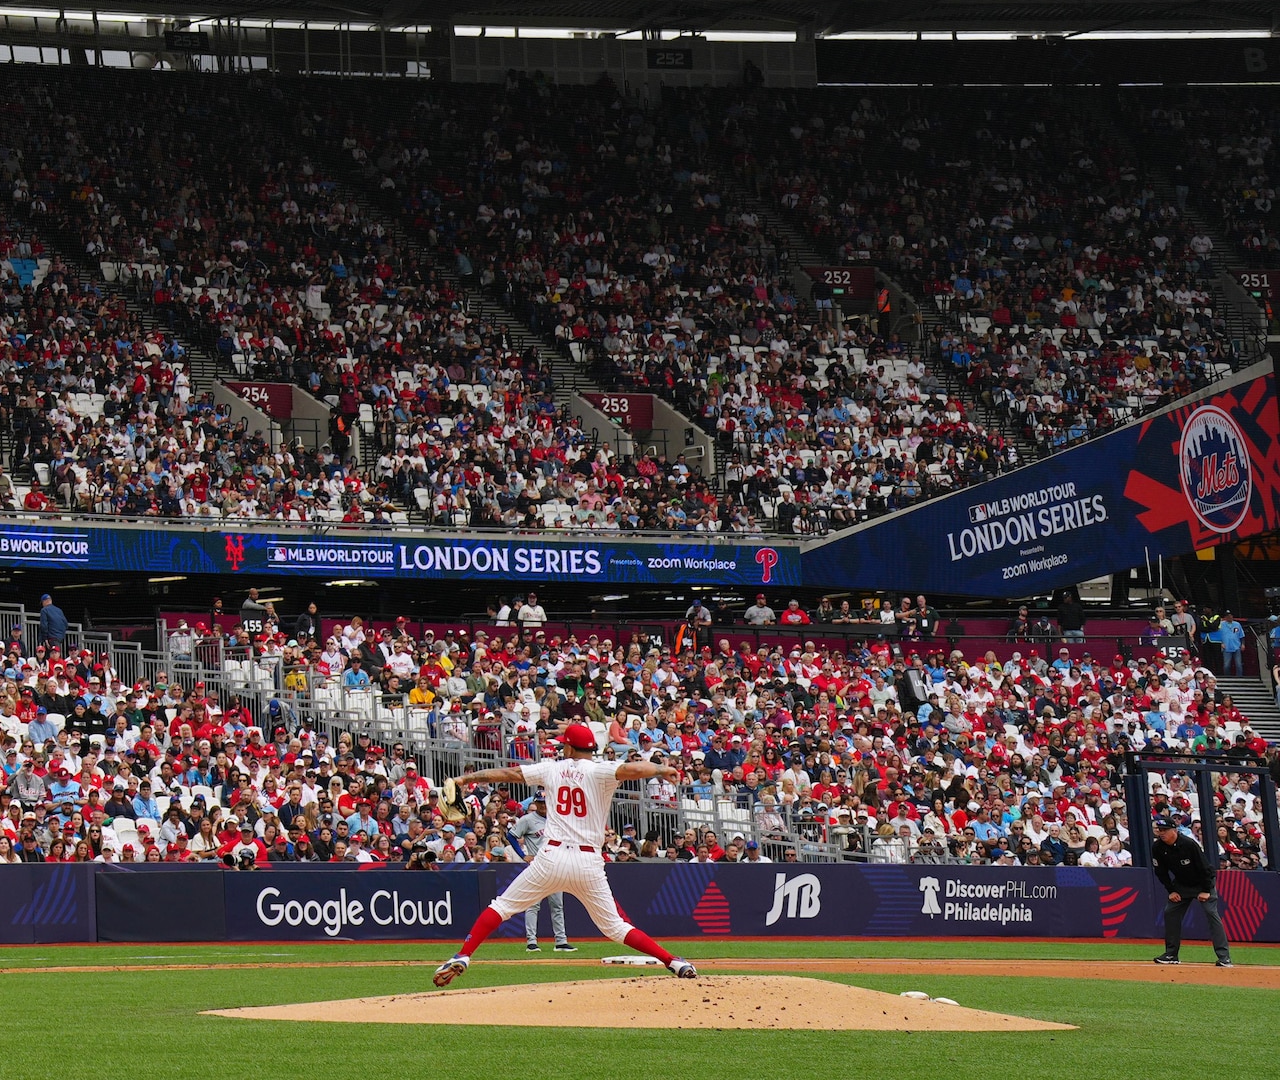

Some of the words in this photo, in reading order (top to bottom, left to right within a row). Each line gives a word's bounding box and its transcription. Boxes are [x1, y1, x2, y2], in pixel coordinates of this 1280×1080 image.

[656, 52, 684, 65] 252
[824, 270, 851, 285] 252
[1240, 273, 1270, 288] 251
[242, 387, 269, 403] 254
[601, 397, 629, 413] 253
[1197, 451, 1239, 499] Mets
[986, 502, 1010, 518] MLB
[947, 513, 1037, 561] LONDON
[1038, 494, 1107, 537] SERIES
[288, 548, 314, 562] MLB
[400, 546, 509, 573] LONDON
[514, 548, 602, 574] SERIES
[648, 558, 681, 568] zoom
[683, 558, 736, 571] Workplace
[1002, 563, 1029, 579] zoom
[1029, 553, 1068, 572] Workplace
[243, 620, 262, 632] 155
[650, 635, 662, 647] 54
[556, 786, 587, 818] 99
[945, 879, 1057, 899] DiscoverPHL.com
[765, 872, 821, 927] JTB
[256, 885, 364, 937] Google
[370, 889, 452, 926] Cloud
[944, 902, 1033, 926] Philadelphia
